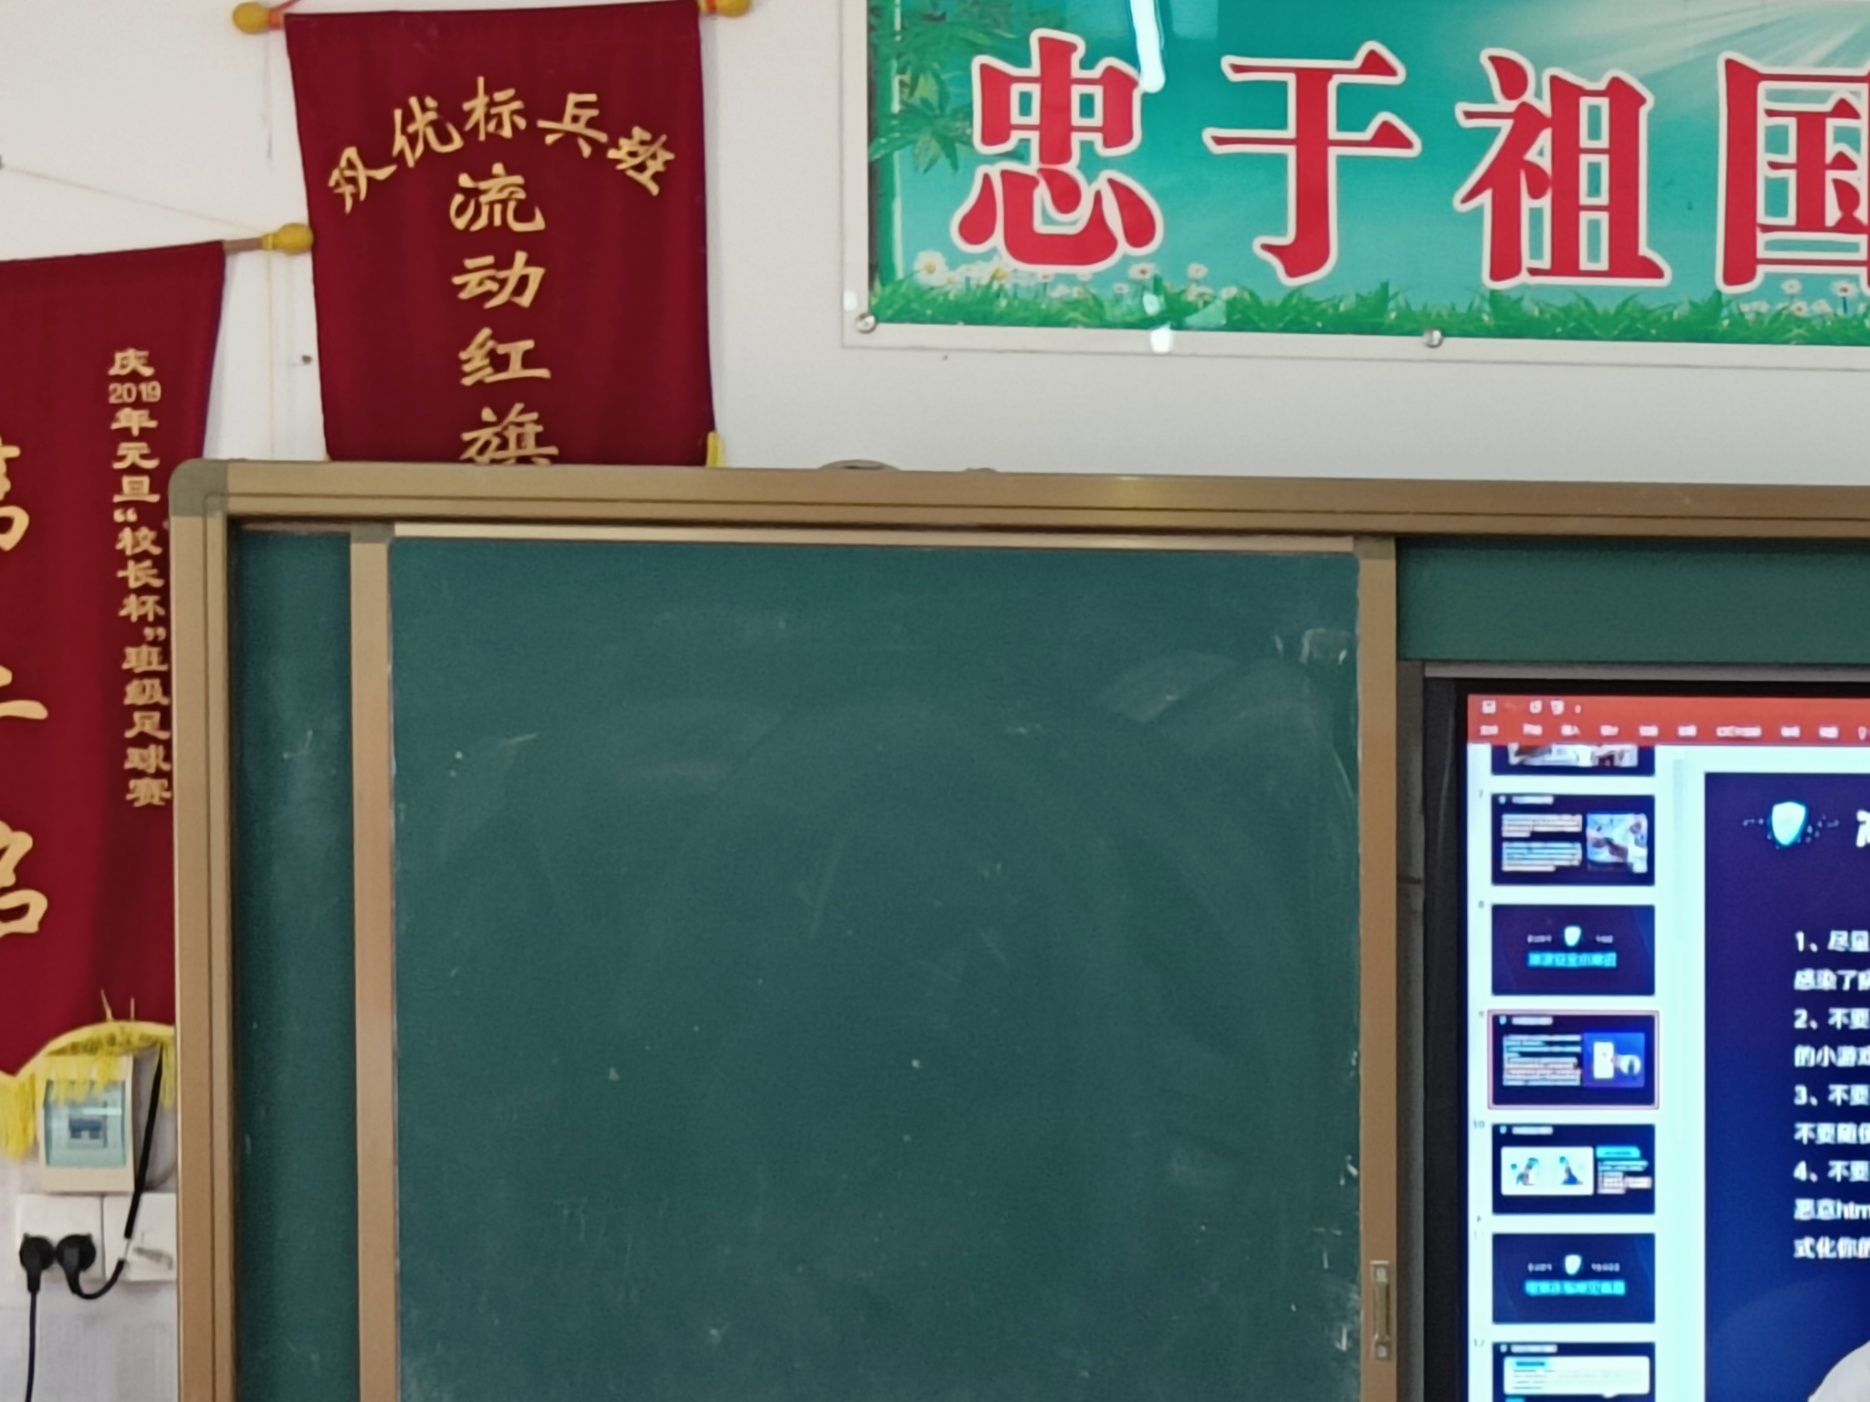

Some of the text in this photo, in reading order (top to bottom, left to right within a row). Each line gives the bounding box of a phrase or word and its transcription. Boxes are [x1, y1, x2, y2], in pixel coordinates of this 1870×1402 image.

[328, 75, 676, 214] 双优标兵班
[449, 162, 560, 465] 流动红旗
